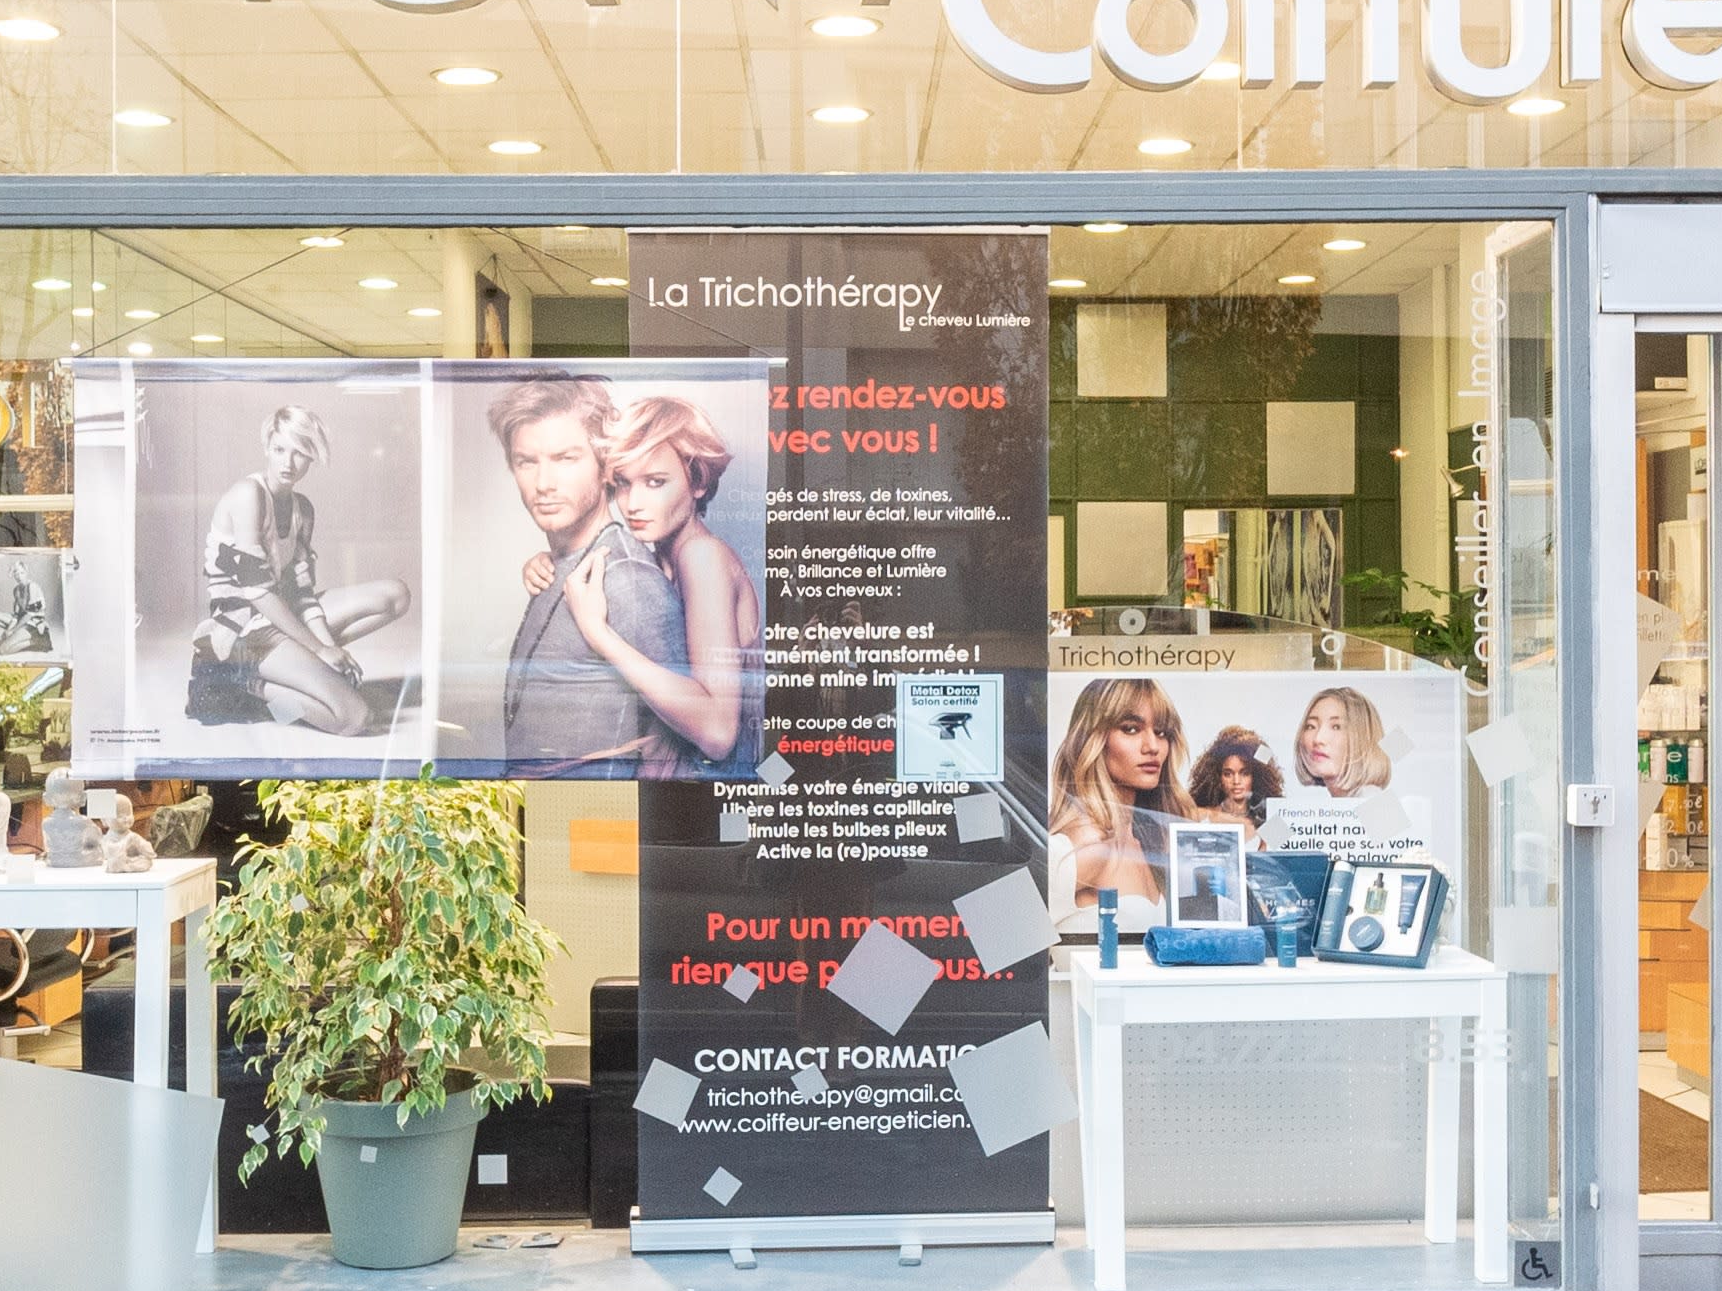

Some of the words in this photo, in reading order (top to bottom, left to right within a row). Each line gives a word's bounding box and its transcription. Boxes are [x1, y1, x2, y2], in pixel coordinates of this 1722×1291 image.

[647, 277, 689, 308] La
[698, 275, 944, 316] Trichothérapy
[918, 313, 973, 328] cheveu
[975, 312, 1031, 328] Lumière
[1457, 268, 1508, 397] Image
[797, 379, 1008, 410] rendez-vous
[768, 427, 832, 453] vec
[841, 427, 921, 453] vous
[928, 423, 939, 452] !
[1471, 422, 1495, 471] en
[796, 489, 818, 503] de
[822, 488, 866, 505] stress,
[870, 489, 892, 503] de
[895, 487, 954, 504] toxines,
[766, 508, 830, 524] perdent
[833, 507, 862, 521] leur
[865, 506, 910, 523] éclat,
[913, 506, 942, 521] leur
[767, 546, 798, 560] soin
[801, 544, 897, 562] énergétique
[900, 545, 937, 559] offre
[797, 563, 863, 578] Brillance
[866, 564, 882, 578] et
[886, 562, 947, 578] Lumière
[780, 581, 792, 597] À
[796, 584, 823, 597] vos
[826, 582, 894, 597] cheveux
[1454, 491, 1494, 698] Conseiller
[764, 623, 800, 640] otre
[804, 622, 901, 640] chevelure
[906, 623, 935, 639] est
[854, 644, 970, 664] transformée
[1058, 643, 1236, 671] Trichothérapy
[765, 670, 815, 688] onne
[819, 669, 868, 688] mine
[911, 685, 944, 696] Metal
[946, 685, 979, 696] Detox
[911, 697, 940, 706] Salon
[942, 697, 978, 706] certifié
[795, 717, 848, 735] coupe
[851, 715, 873, 730] de
[778, 734, 895, 757] énergétique
[713, 781, 799, 798] Dynamse
[803, 782, 848, 796] votre
[851, 778, 919, 798] énergie
[923, 780, 970, 795] vitale
[779, 802, 803, 817] les
[807, 802, 869, 817] toxines
[873, 800, 956, 817] capillaire
[747, 822, 800, 838] timule
[803, 822, 829, 838] les
[832, 821, 891, 838] bulbes
[894, 821, 947, 840] pileux
[1288, 822, 1338, 836] ésultat
[756, 843, 813, 859] Active
[816, 843, 833, 858] la
[836, 842, 929, 861] (re)pousse
[1328, 839, 1356, 851] que
[707, 911, 781, 942] Pour
[789, 914, 831, 940] un
[840, 913, 970, 940] momen
[670, 956, 732, 985] rien
[747, 959, 809, 990] que
[694, 1047, 830, 1072] CONTACT
[837, 1044, 980, 1070] FORMATI
[677, 1110, 972, 1135] www.coiffeur-energeticien.
